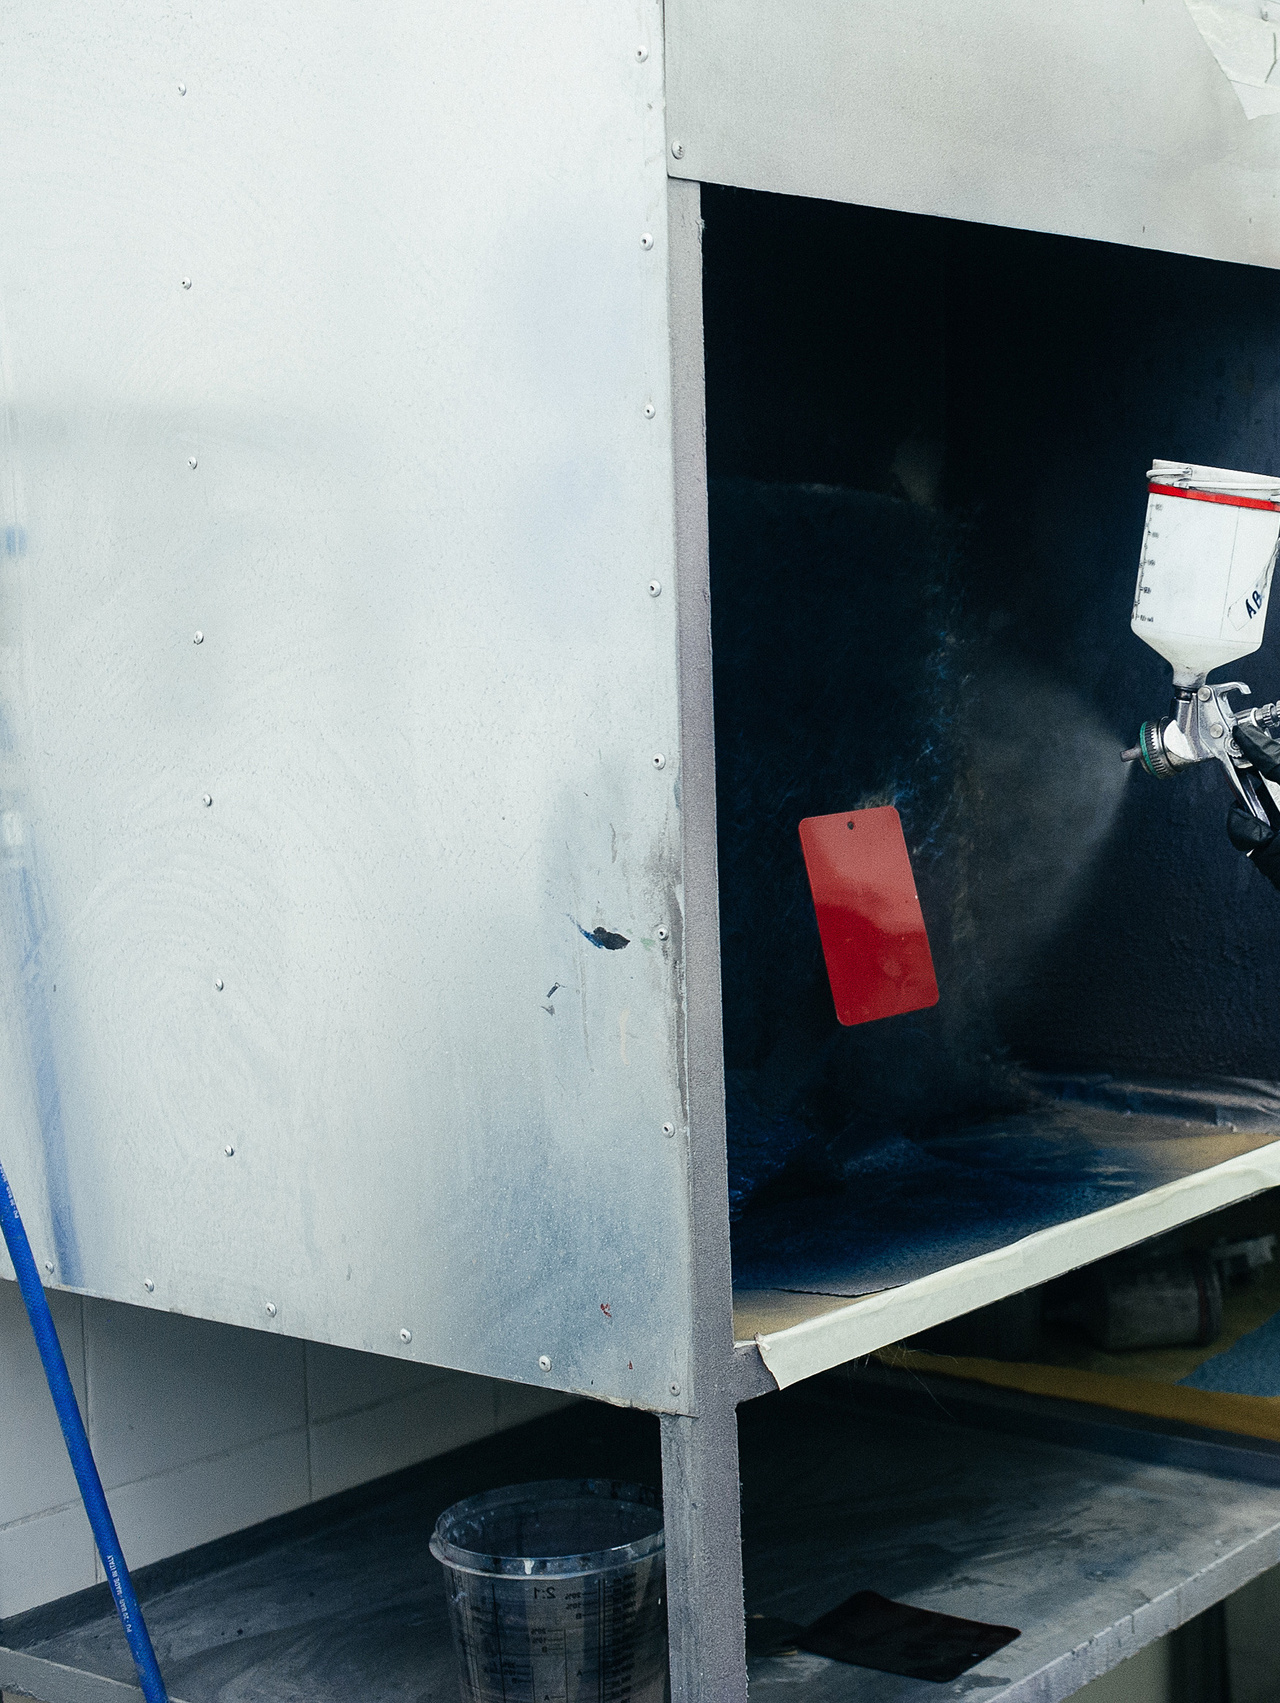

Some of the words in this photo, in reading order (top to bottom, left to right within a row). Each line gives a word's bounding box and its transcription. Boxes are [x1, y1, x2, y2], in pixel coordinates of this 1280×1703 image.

[106, 1554, 116, 1571] ITALY
[113, 1577, 123, 1596] MADE
[126, 1623, 132, 1633] PU
